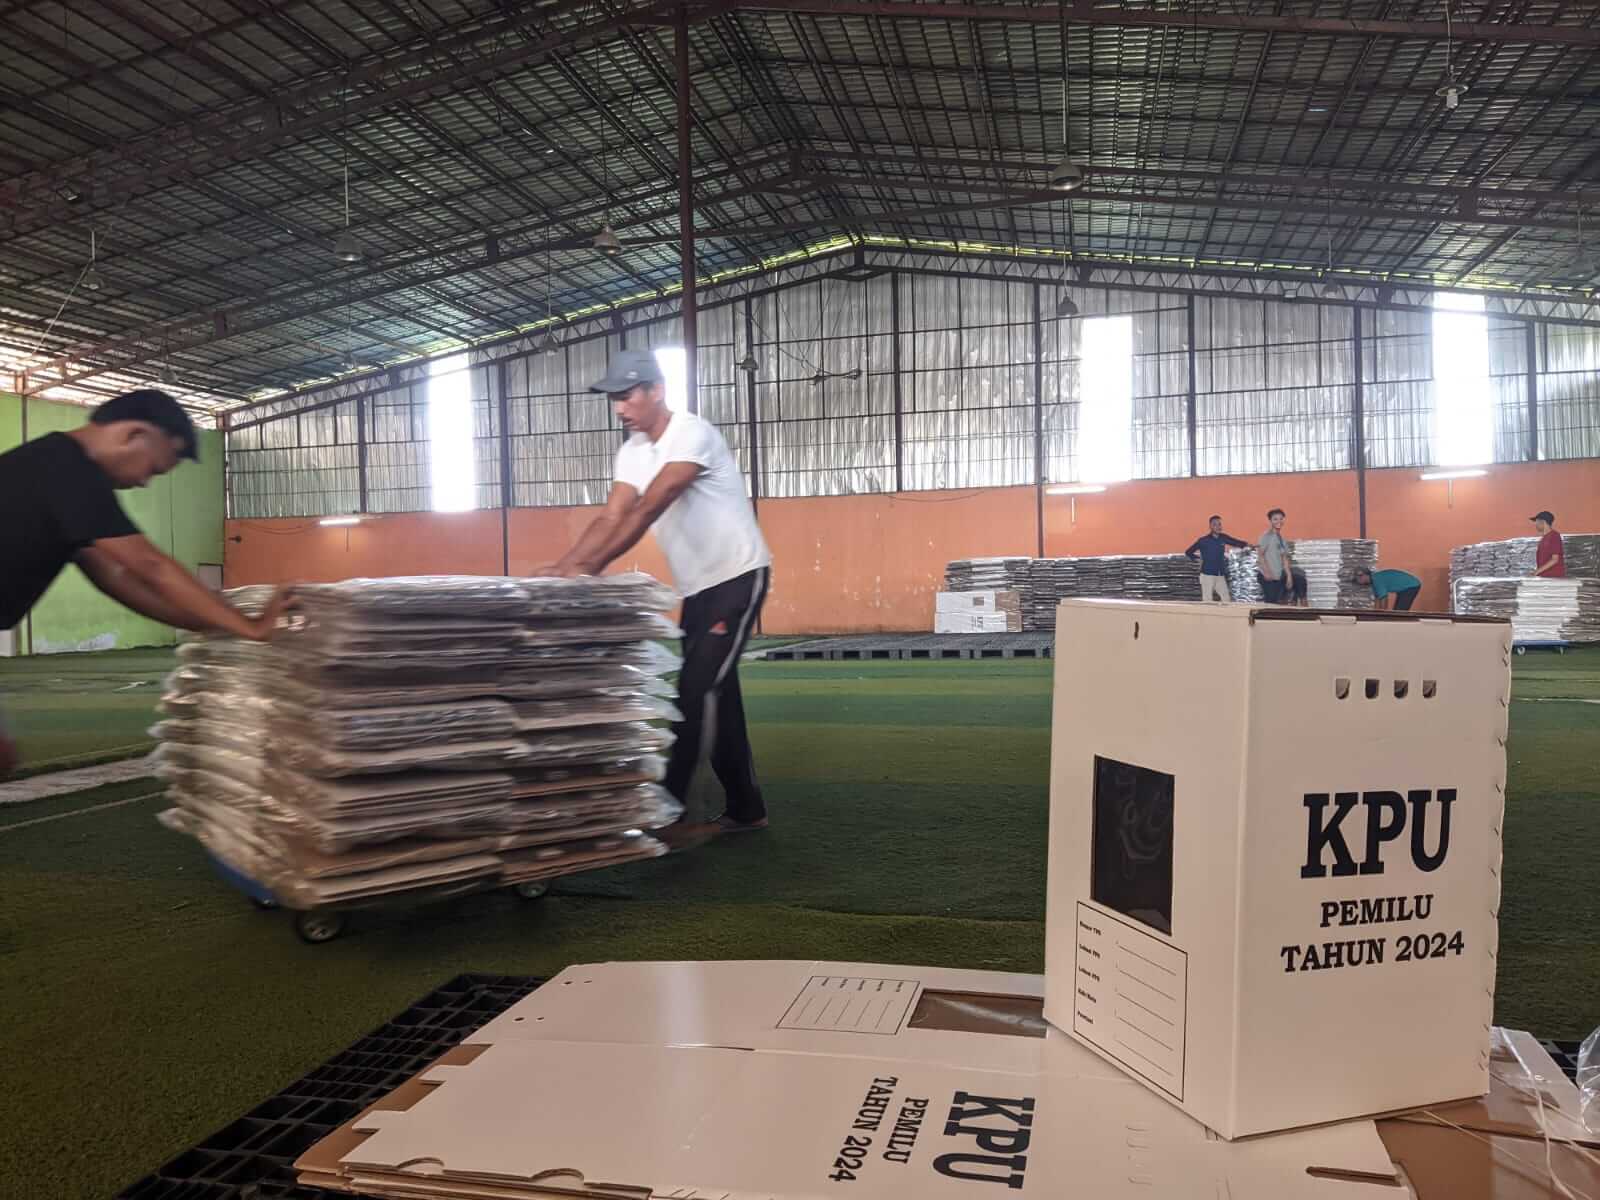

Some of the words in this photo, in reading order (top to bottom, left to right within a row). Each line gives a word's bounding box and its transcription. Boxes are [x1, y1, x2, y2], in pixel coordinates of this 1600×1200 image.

[1301, 789, 1457, 879] KPU
[1320, 894, 1434, 927] PEMILU
[1281, 938, 1386, 972] TAHUN
[1395, 931, 1464, 962] 2024
[852, 1077, 899, 1132] TAHUN
[883, 1097, 929, 1164] PEMILU
[829, 1136, 872, 1181] 2024
[933, 1092, 1035, 1189] KPU
